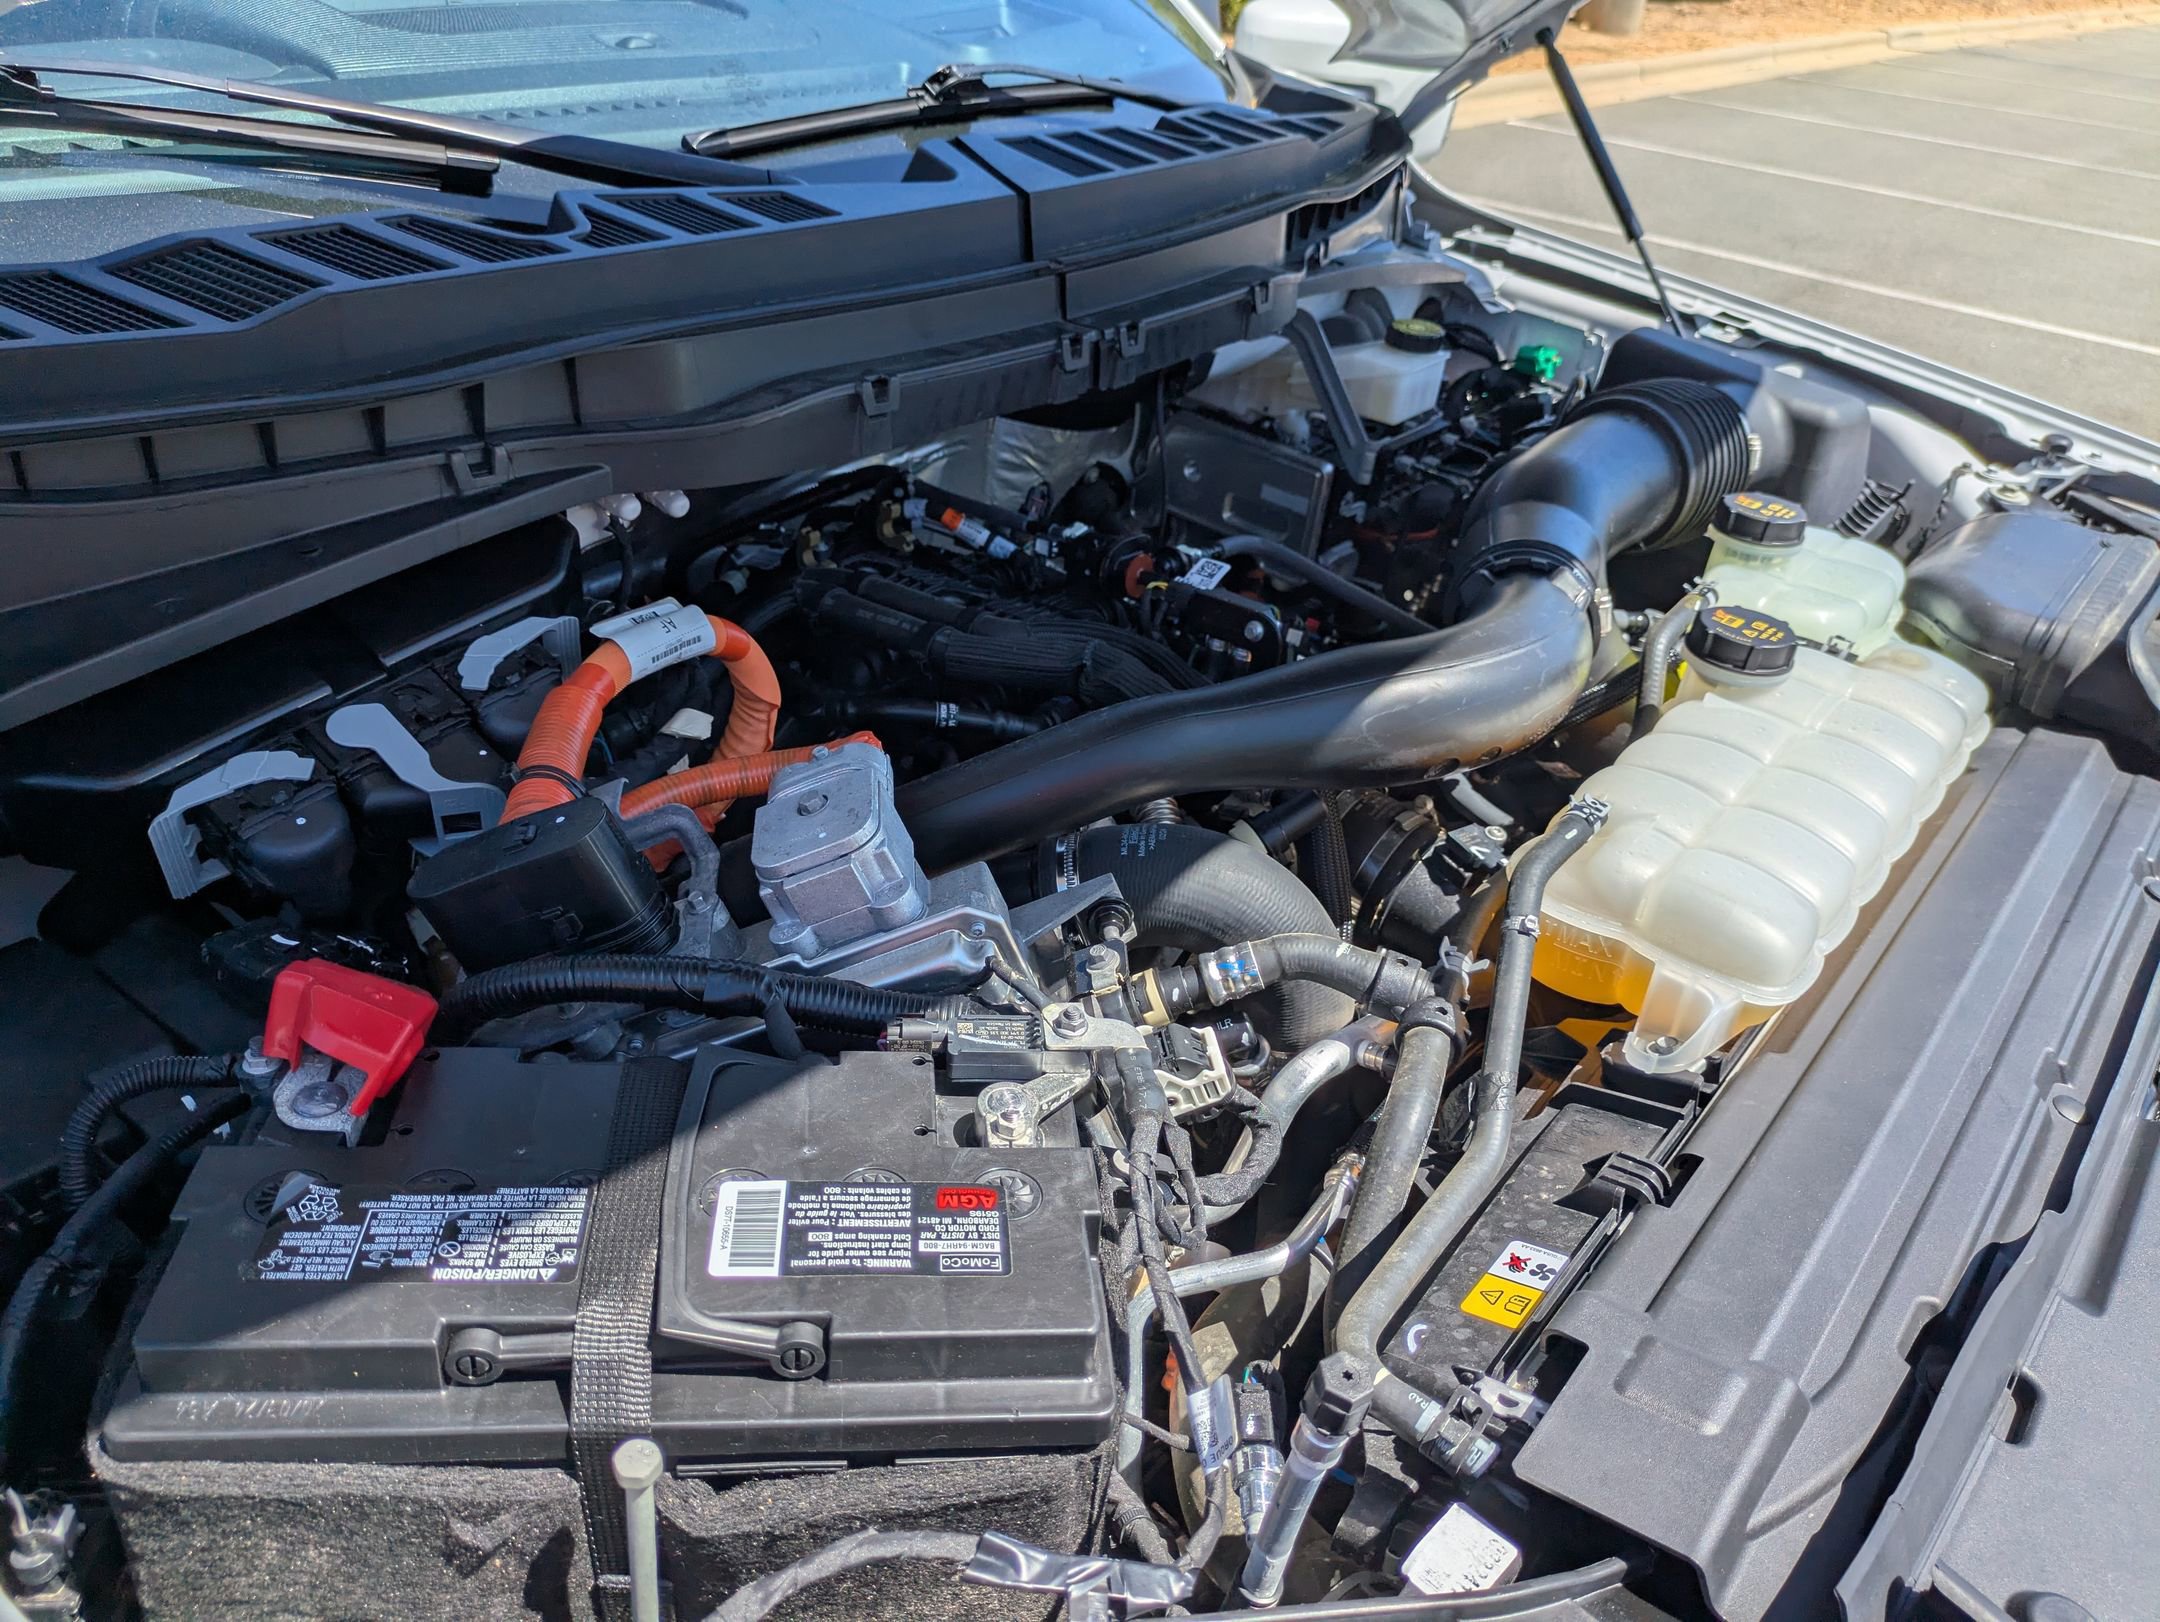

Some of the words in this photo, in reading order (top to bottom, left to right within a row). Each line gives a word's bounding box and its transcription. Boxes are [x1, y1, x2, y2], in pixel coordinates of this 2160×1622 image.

[308, 1183, 340, 1193] RECYCLAGE
[860, 1194, 900, 1202] demarrage
[938, 1194, 995, 1208] AGM
[822, 1202, 829, 1210] la
[812, 1219, 829, 1227] Pour
[837, 1219, 911, 1227] AVERTISSEMENT
[942, 1216, 952, 1224] MI
[954, 1216, 999, 1224] DEARBORN,
[283, 1232, 311, 1240] MÉDECIN
[469, 1235, 492, 1243] ÉVITER
[834, 1232, 856, 1240] amps
[858, 1232, 891, 1240] cranking
[822, 1249, 843, 1257] guide
[873, 1249, 887, 1257] see
[392, 1258, 428, 1266] SULFURIC
[791, 1257, 826, 1267] personal
[828, 1259, 850, 1267] avoid
[852, 1259, 861, 1267] To
[863, 1259, 911, 1267] WARNING:
[942, 1258, 999, 1268] FoMoCo
[290, 1264, 302, 1272] GET
[329, 1264, 346, 1272] WITH
[432, 1268, 538, 1280] DANGER/POISON
[1408, 1391, 1429, 1410] RAD
